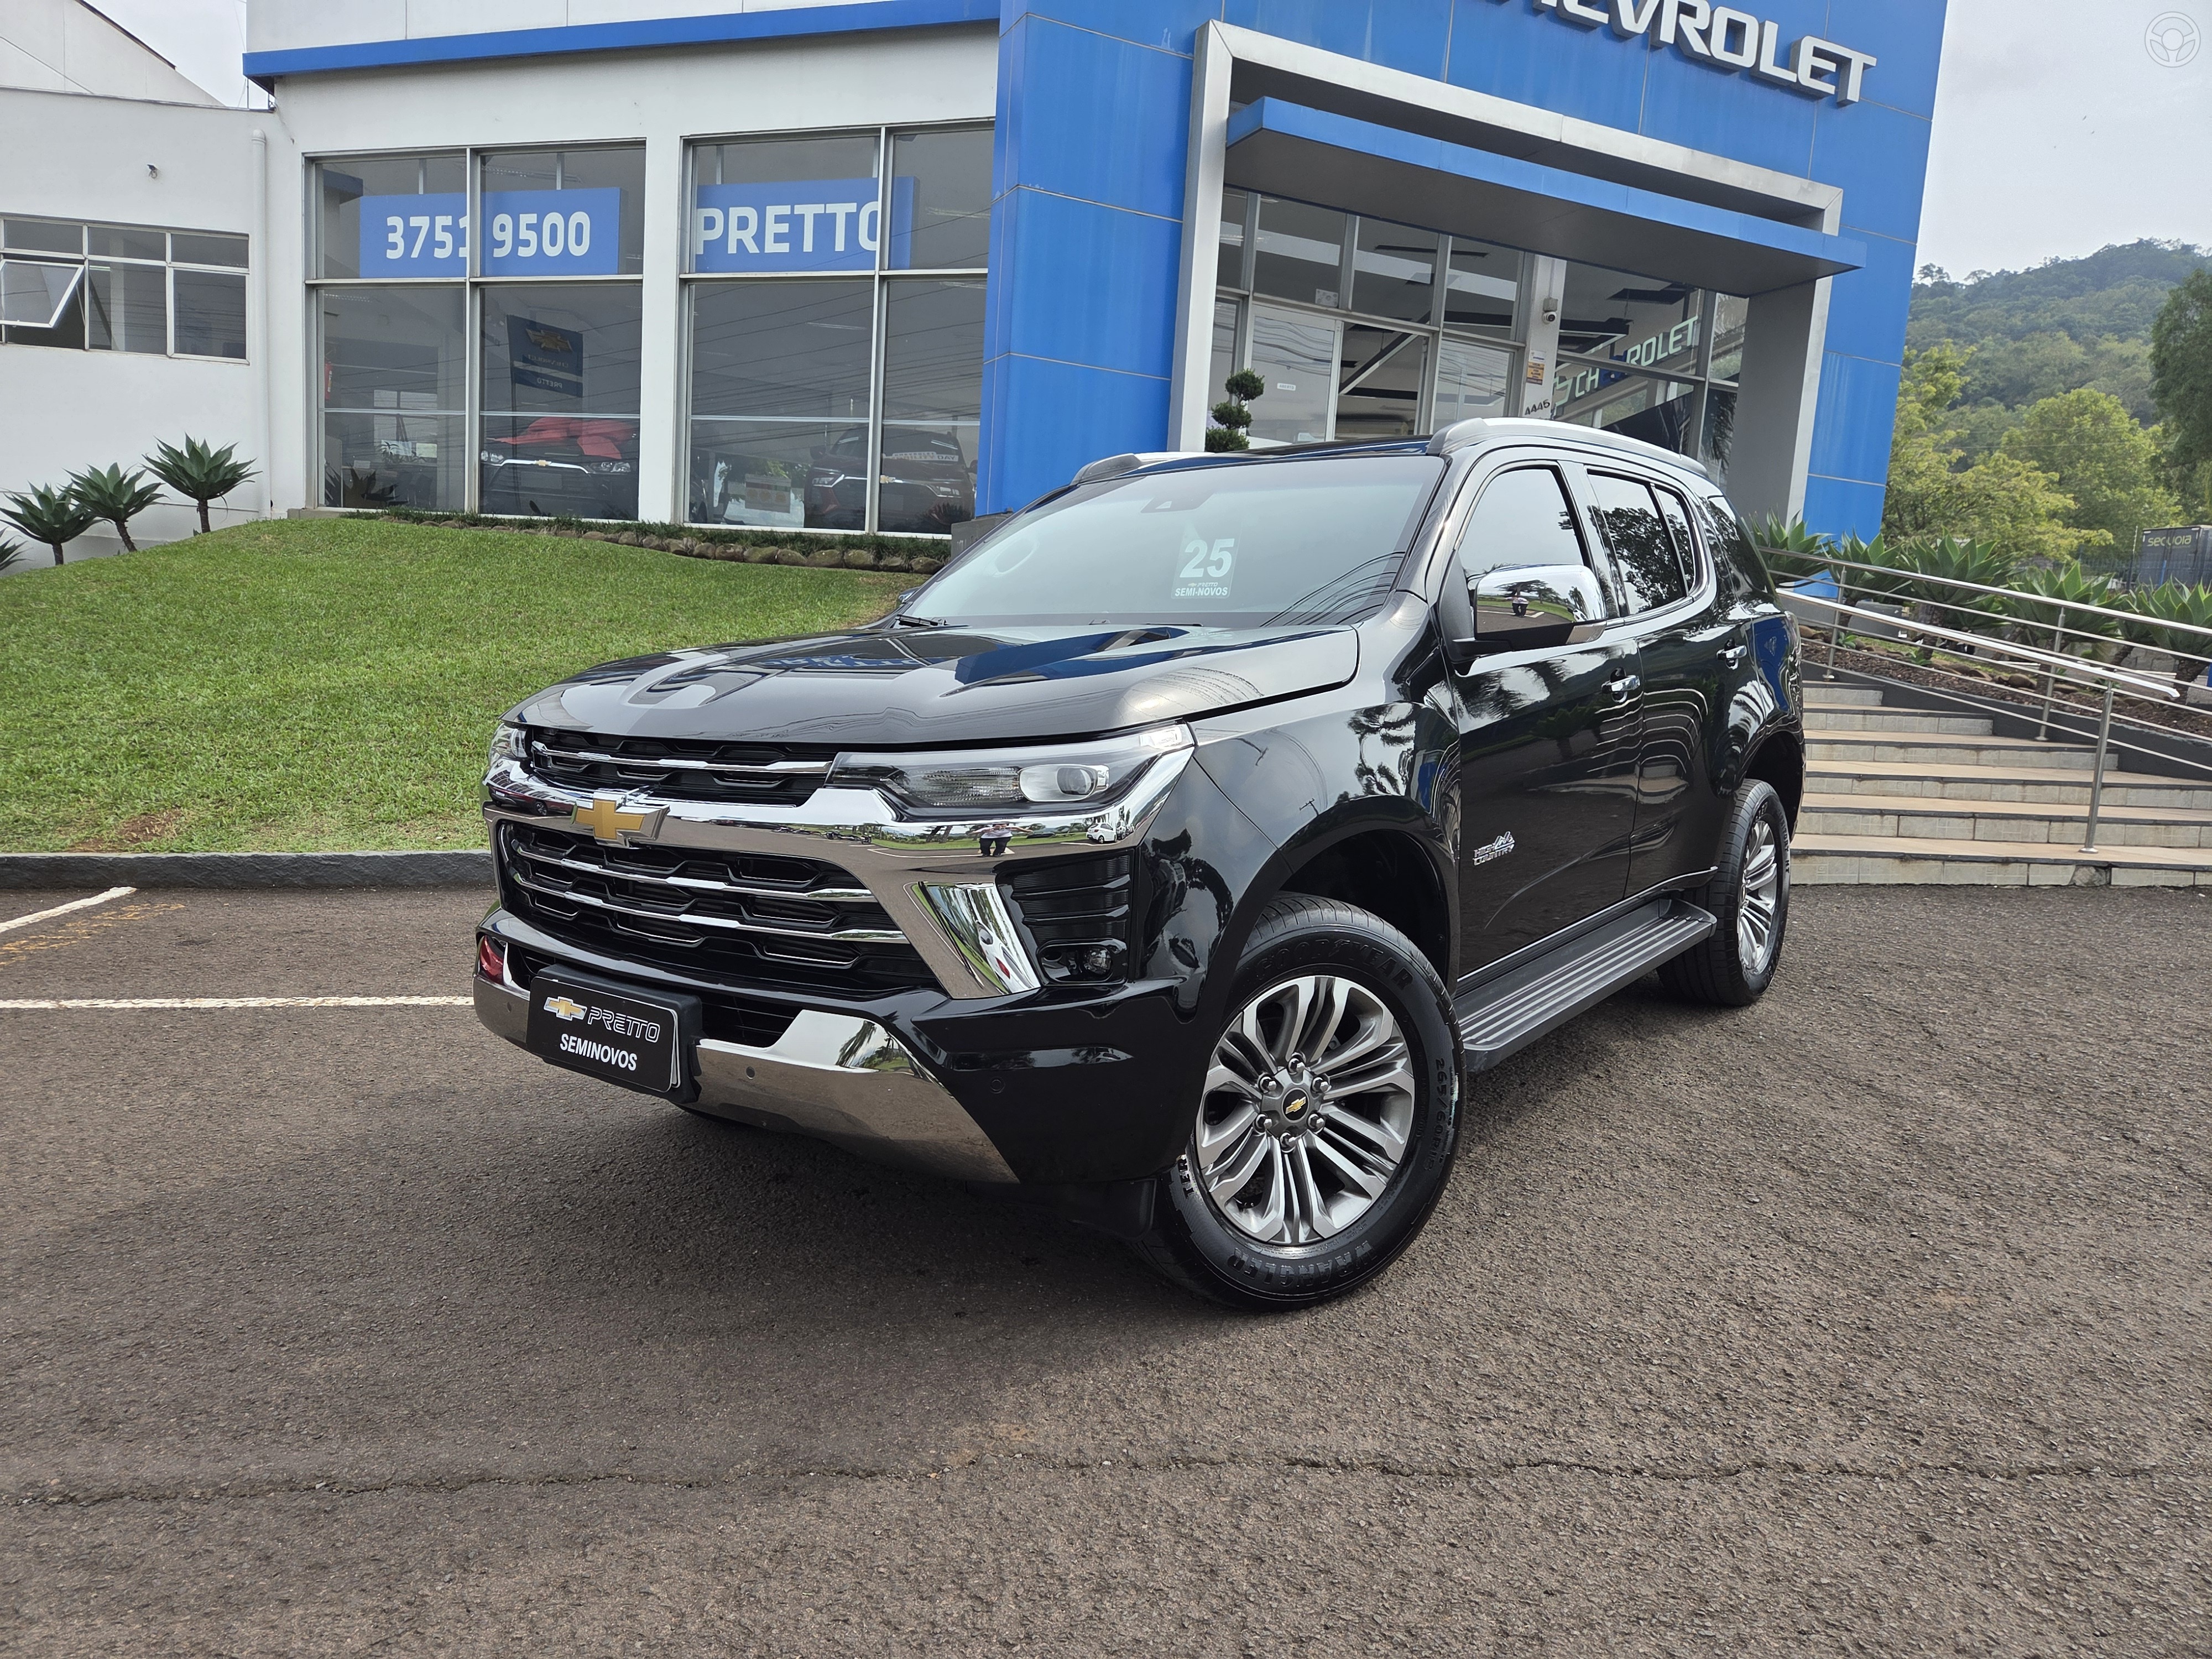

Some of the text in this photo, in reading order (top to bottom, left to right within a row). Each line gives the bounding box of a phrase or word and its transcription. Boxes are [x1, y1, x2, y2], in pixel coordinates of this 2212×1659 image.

[1541, 0, 1877, 102] VROLET
[493, 211, 591, 258] 9500
[696, 201, 878, 255] PRETTO
[1575, 315, 1699, 398] CHROLET
[1180, 539, 1235, 577] 25
[1175, 587, 1228, 597] SEMI-NOVOS
[587, 1006, 661, 1043] PRETTO
[560, 1034, 638, 1071] SEMINOVOS
[1227, 1240, 1378, 1288] WRANGLER
